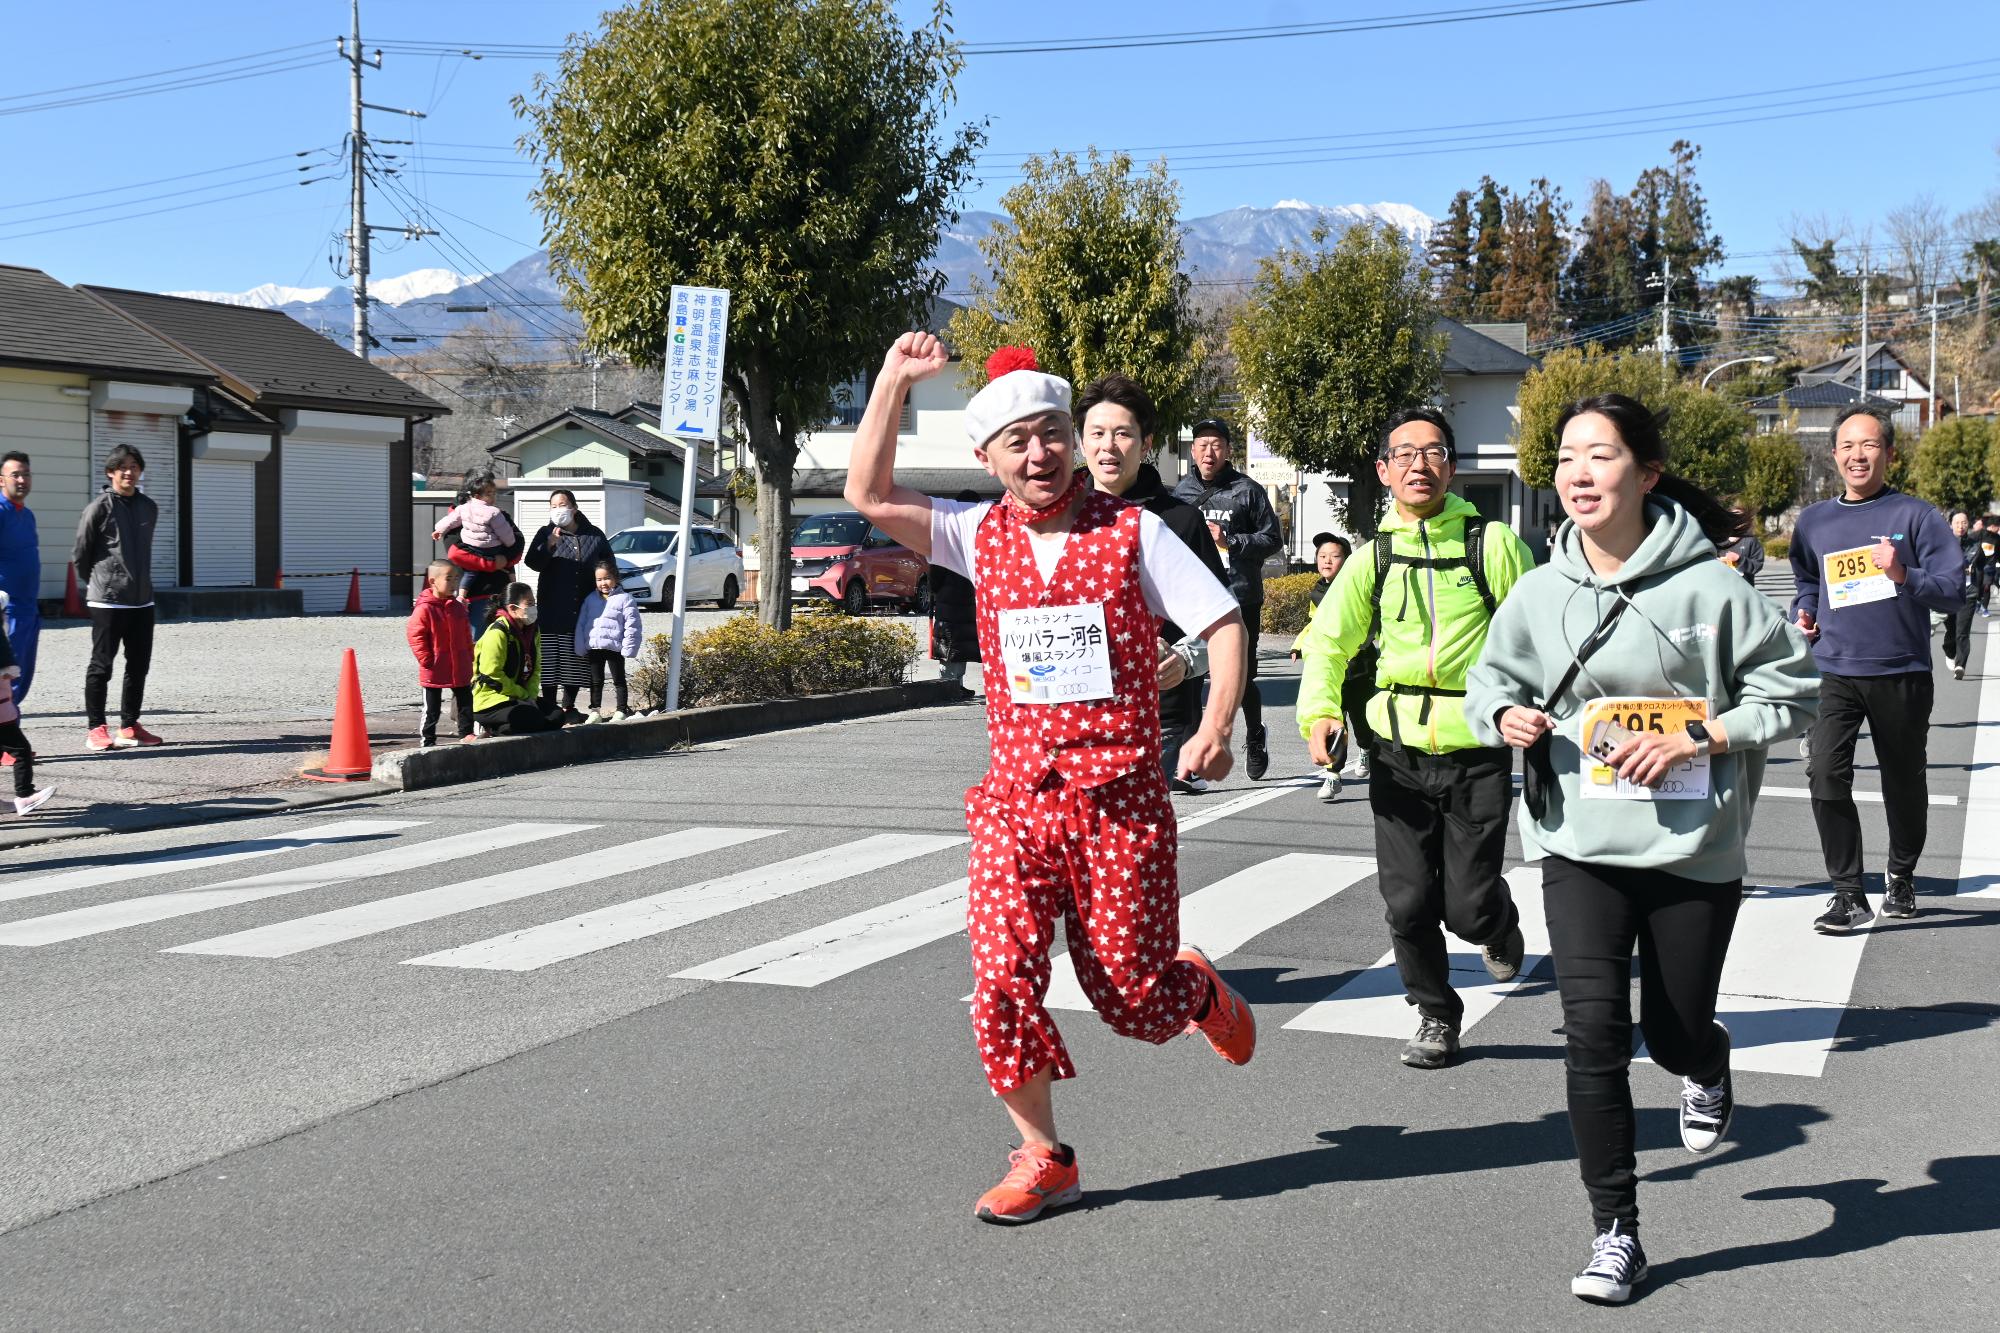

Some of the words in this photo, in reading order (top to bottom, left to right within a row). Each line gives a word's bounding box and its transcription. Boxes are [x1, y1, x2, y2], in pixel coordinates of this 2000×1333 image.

[669, 291, 689, 416] 敷島B&G海洋センター
[685, 294, 706, 412] 神明温泉志麻の湯
[703, 295, 723, 418] 敷島保健福祉センター
[1203, 509, 1231, 521] LETA
[1837, 555, 1866, 578] 295
[1060, 664, 1103, 677] メイコー
